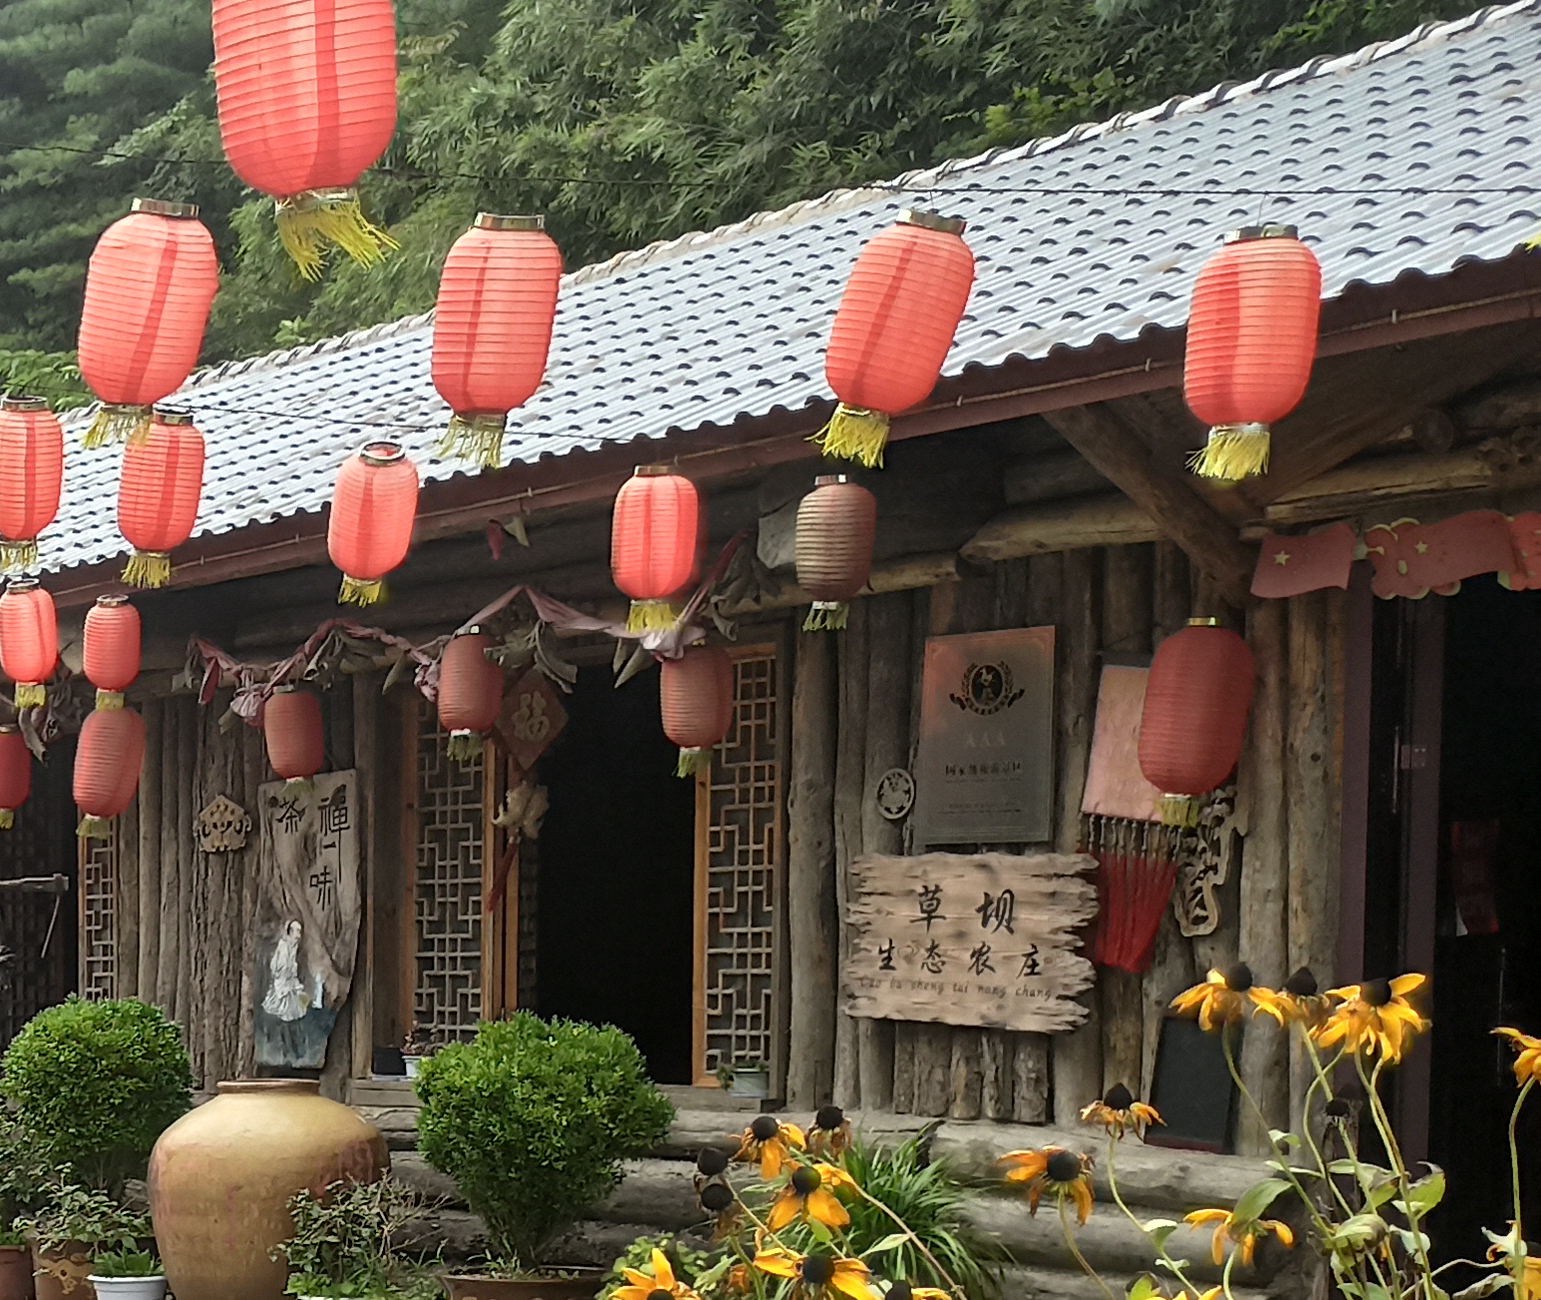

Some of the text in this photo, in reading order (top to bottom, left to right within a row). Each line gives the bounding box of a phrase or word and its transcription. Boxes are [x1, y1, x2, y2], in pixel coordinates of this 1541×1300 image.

[512, 691, 550, 741] 福
[909, 884, 1015, 935] 草坝
[877, 938, 1043, 980] 生态农庄
